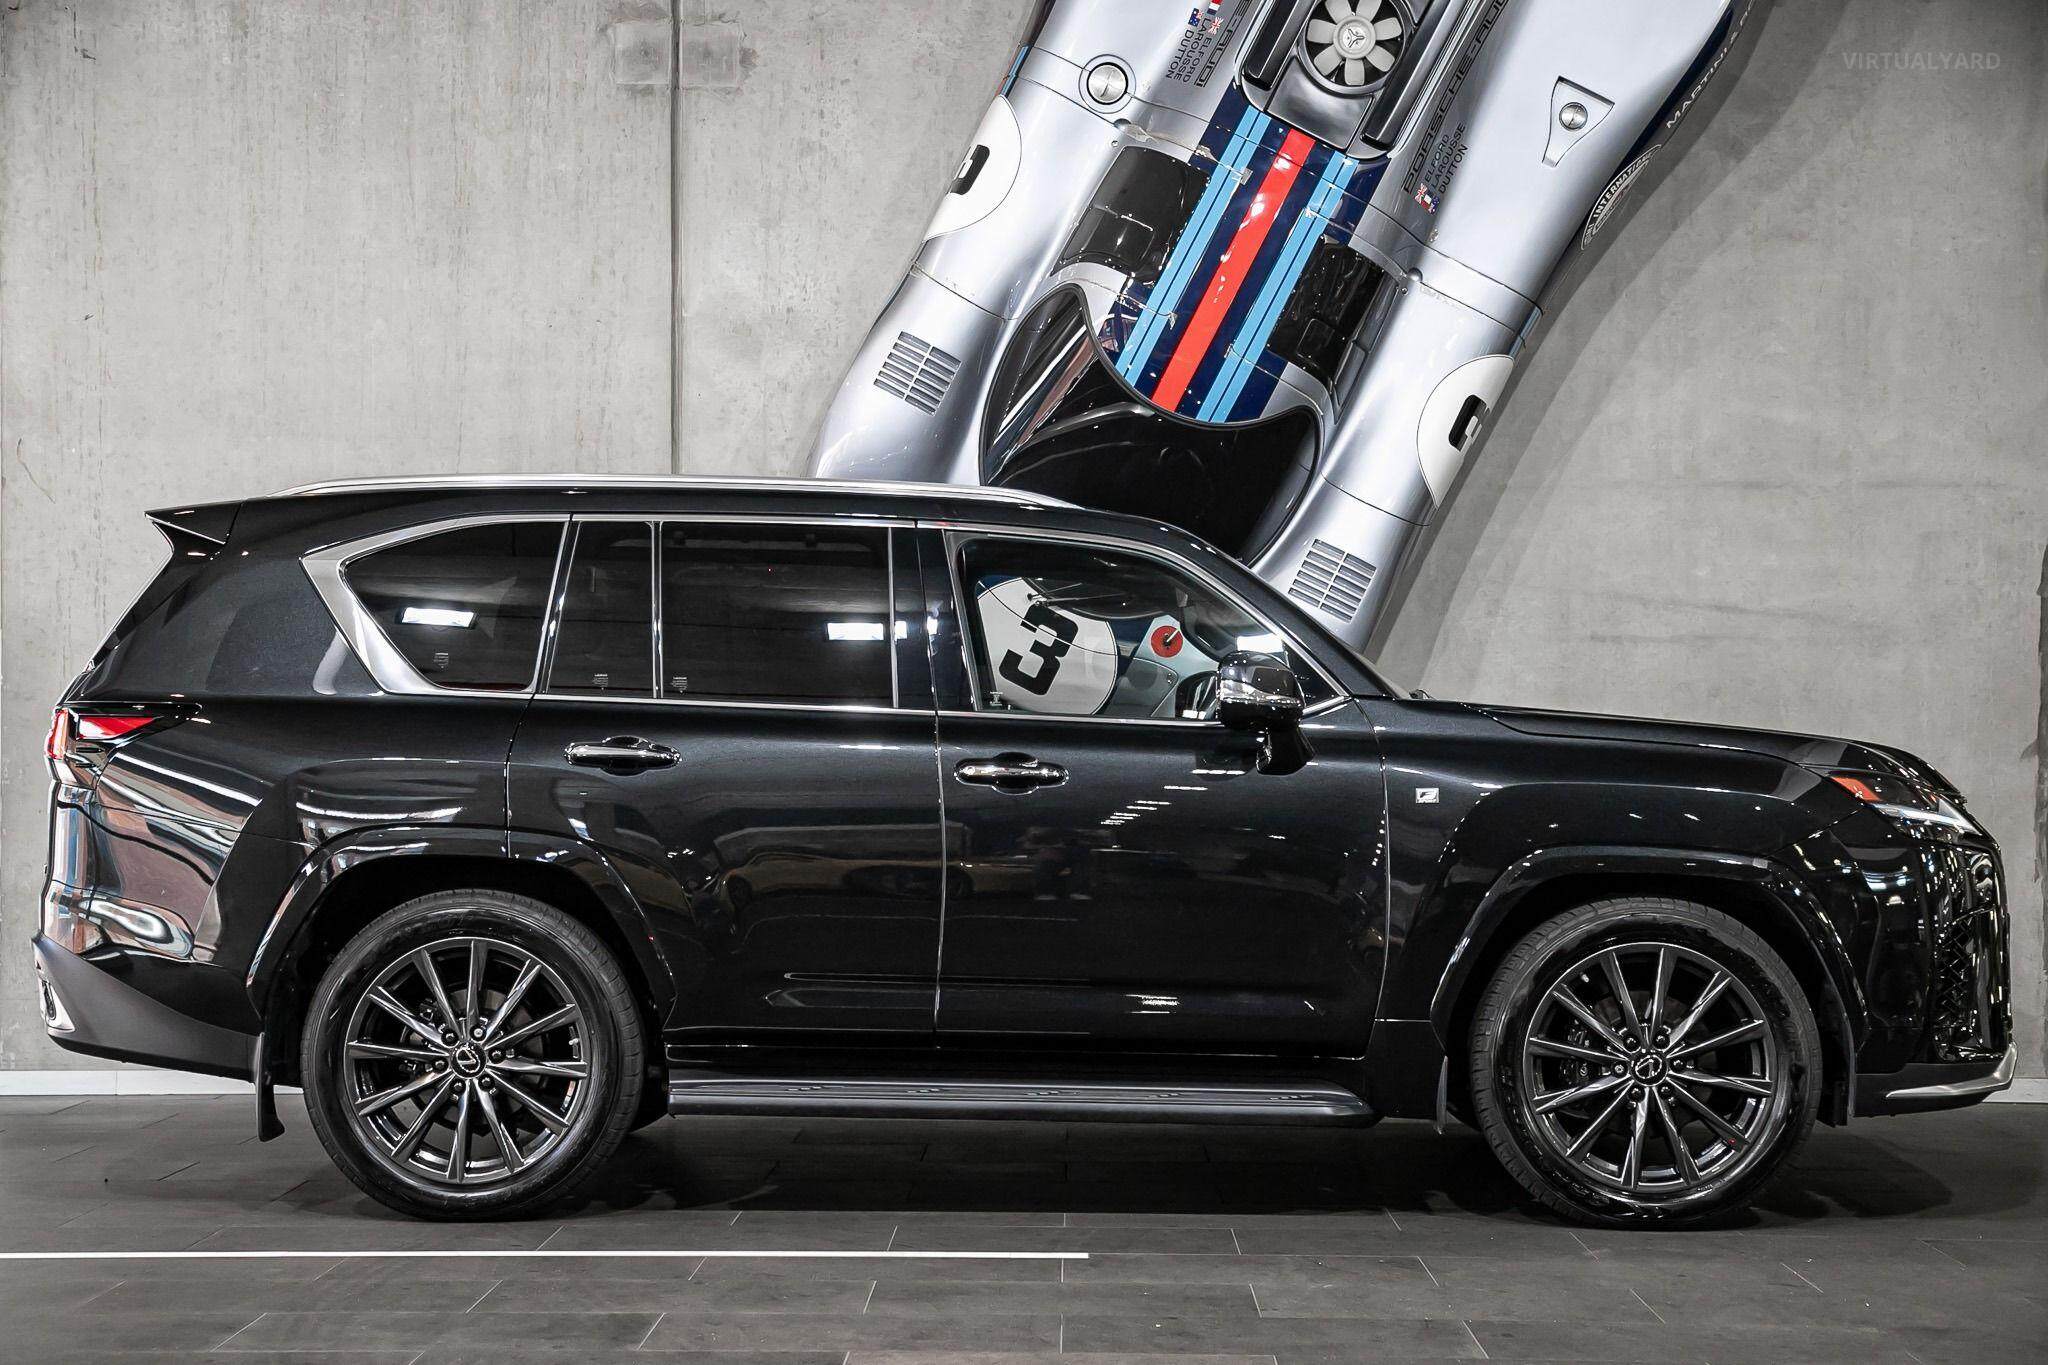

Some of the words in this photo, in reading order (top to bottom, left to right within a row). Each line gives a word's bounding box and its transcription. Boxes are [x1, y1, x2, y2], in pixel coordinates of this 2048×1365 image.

[1165, 29, 1194, 79] DUTTON
[1174, 17, 1212, 82] LAROUSSE
[1183, 37, 1213, 83] ELFORD
[1665, 47, 1727, 129] MARTINI
[1424, 134, 1450, 182] ELFORD
[1431, 122, 1467, 189] LAROUSSE
[1438, 143, 1469, 194] DUTTON
[998, 601, 1079, 696] 3
